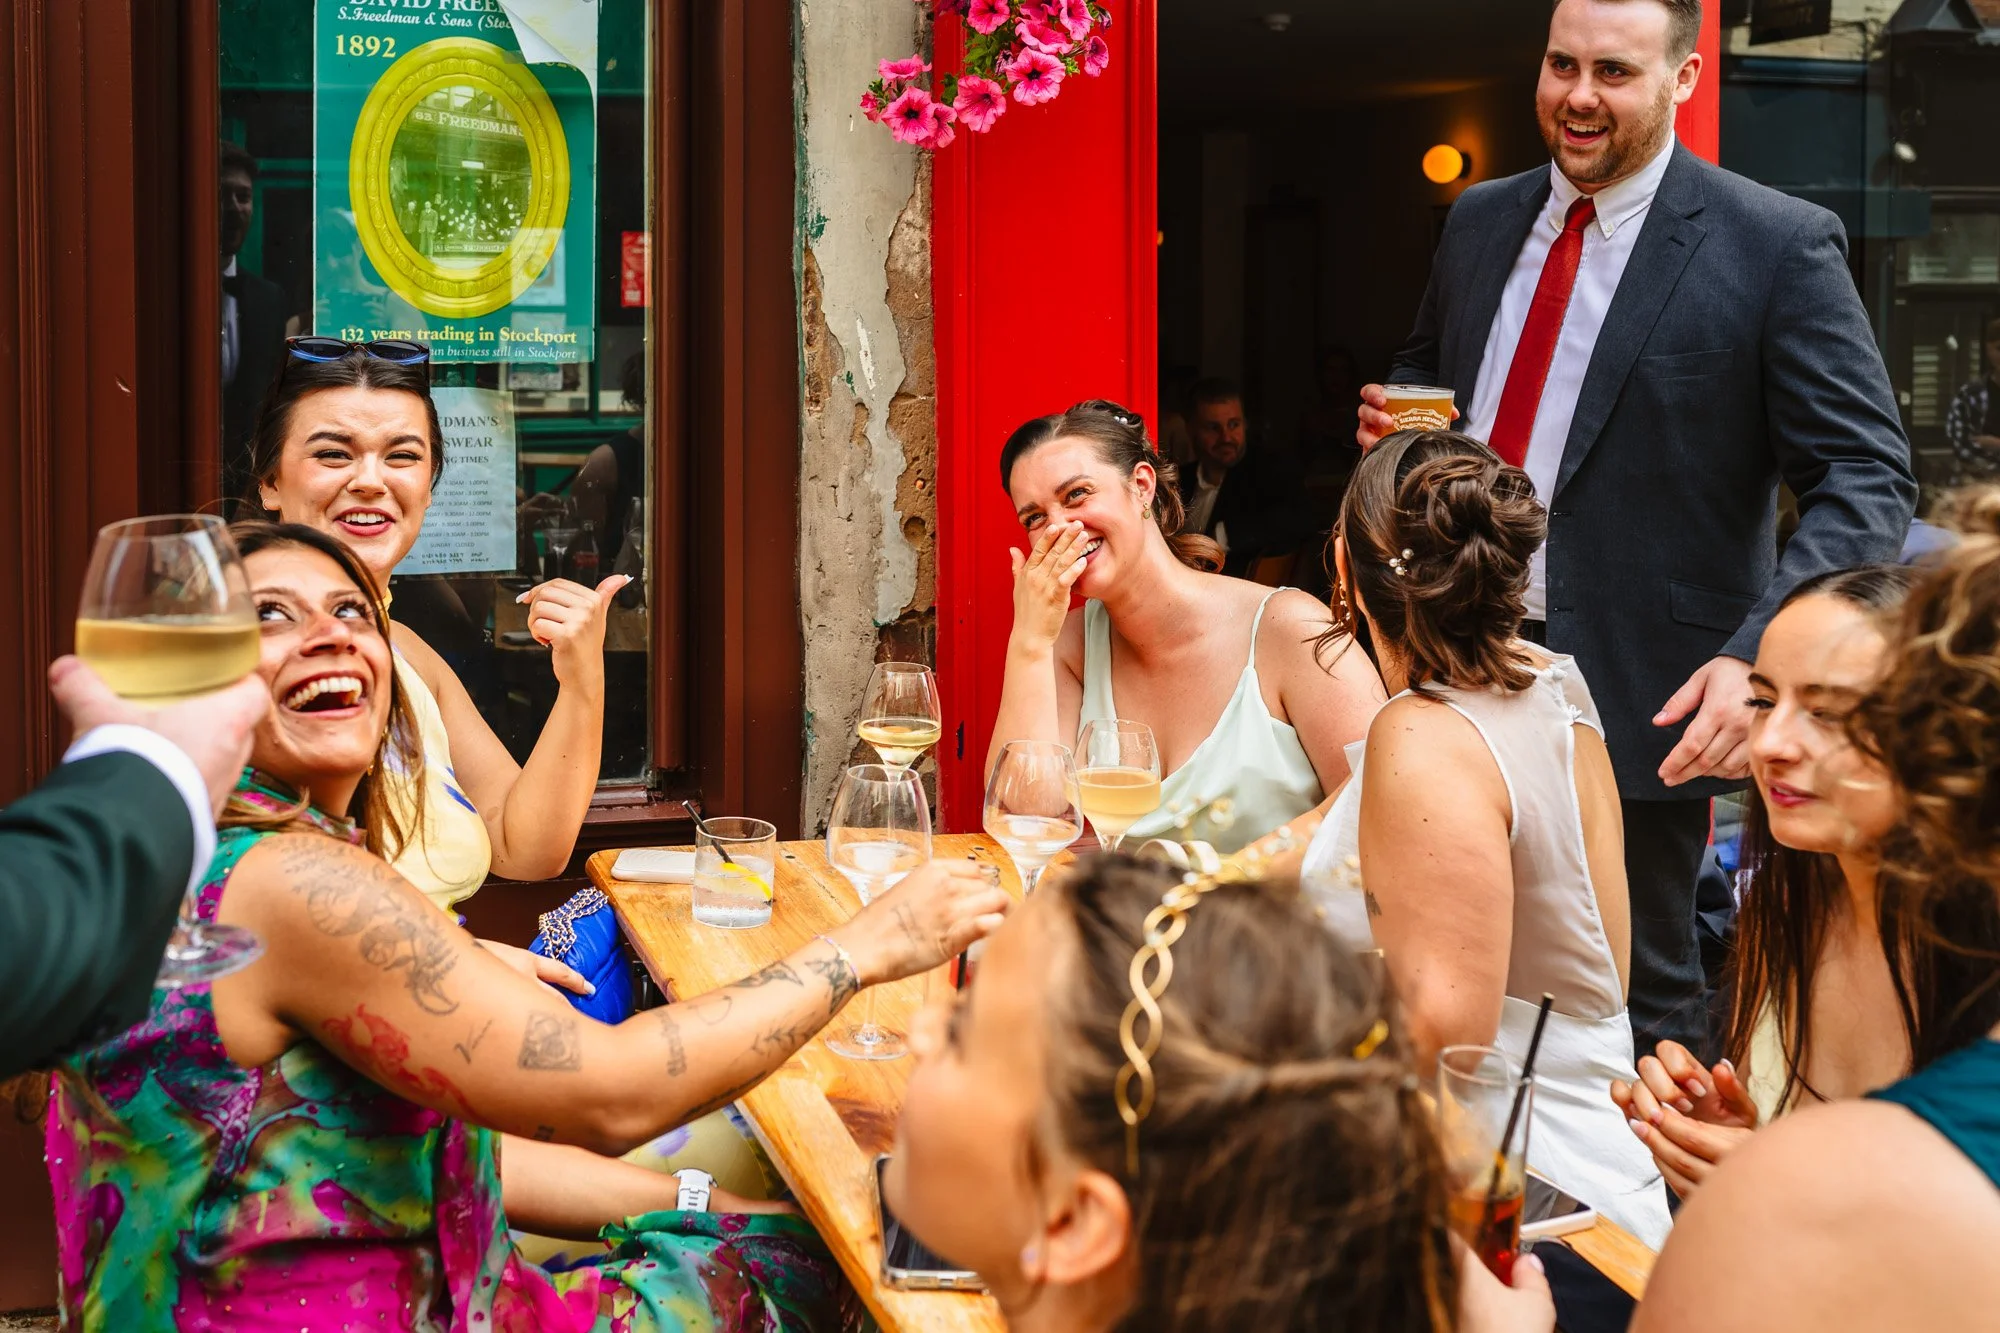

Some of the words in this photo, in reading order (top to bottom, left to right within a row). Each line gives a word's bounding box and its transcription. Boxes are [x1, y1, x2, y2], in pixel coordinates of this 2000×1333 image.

[438, 0, 505, 13] FREE
[337, 6, 421, 24] S.Freedman
[424, 12, 436, 25] &
[440, 13, 473, 28] Sons
[477, 14, 512, 31] (Stoc
[335, 34, 397, 58] 1892
[340, 328, 364, 341] 132
[370, 329, 412, 343] years
[417, 326, 475, 345] trading
[479, 326, 495, 341] in
[500, 326, 577, 346] Stockport
[430, 348, 444, 356] un
[447, 344, 490, 357] business
[492, 345, 512, 357] still
[514, 347, 525, 357] in
[528, 346, 576, 361] Stockport
[440, 416, 498, 428] DMAN'S
[444, 437, 494, 448] SWEAR
